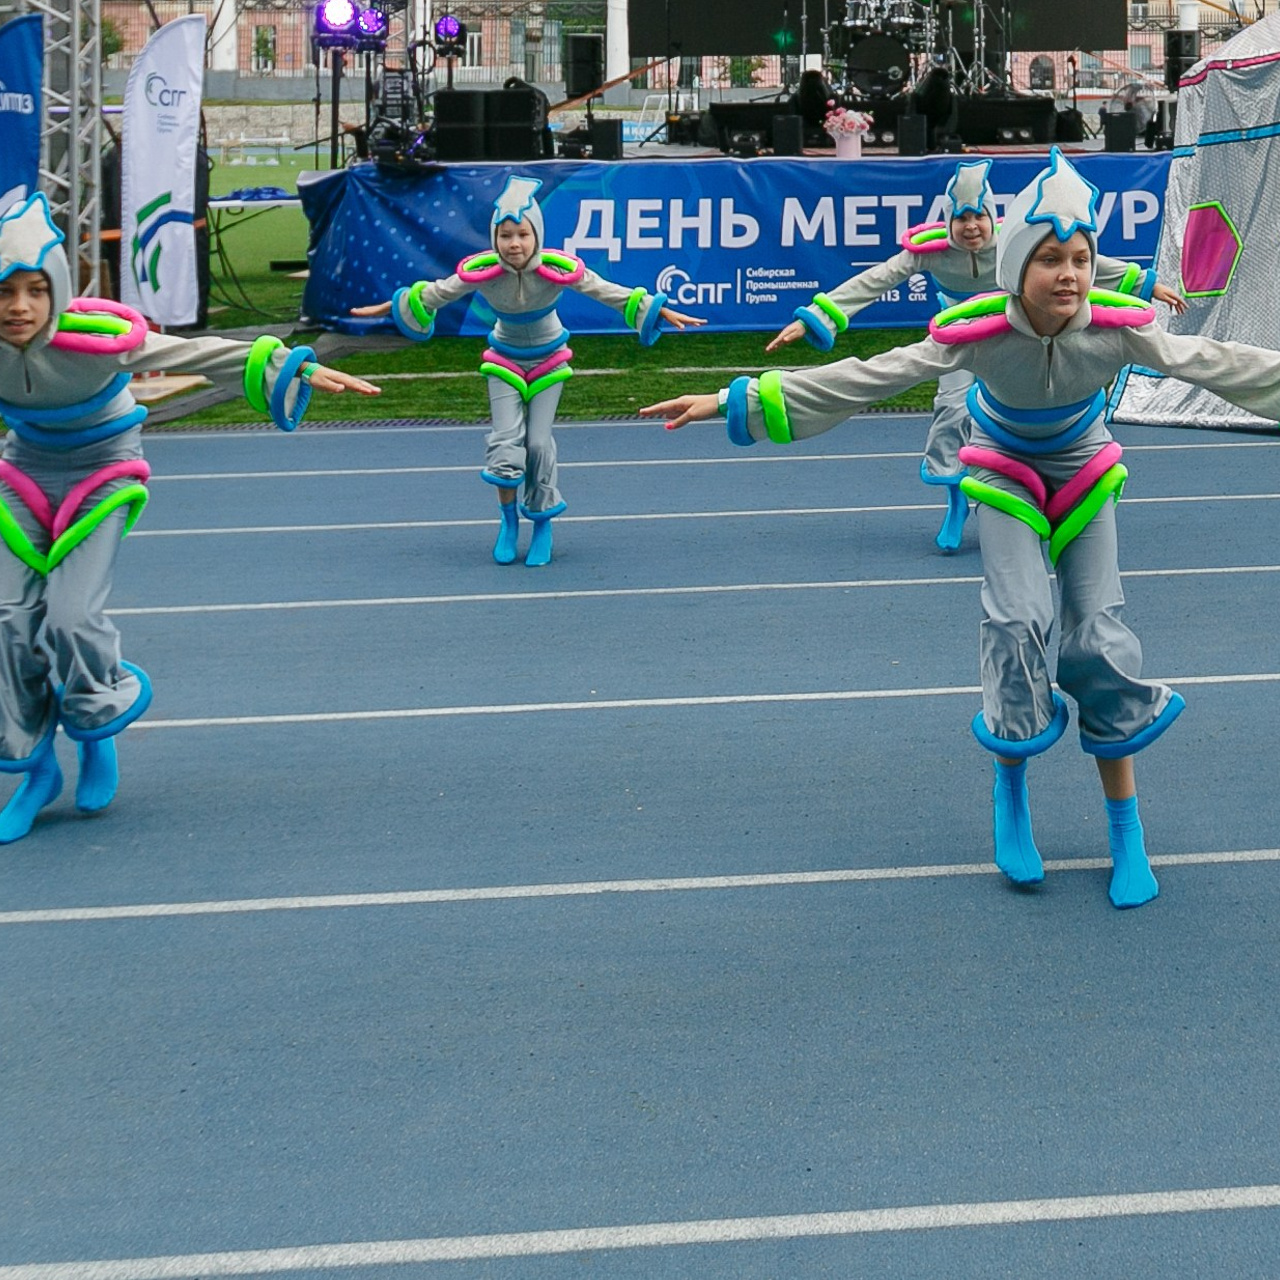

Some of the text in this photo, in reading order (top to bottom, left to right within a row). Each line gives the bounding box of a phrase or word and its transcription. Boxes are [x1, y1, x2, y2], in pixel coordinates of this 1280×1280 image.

[563, 197, 760, 262] ДЕНЬ
[745, 267, 796, 278] Сибирская
[745, 280, 820, 291] Промышленная
[677, 282, 732, 305] СПГ
[745, 293, 778, 304] Группа
[908, 293, 928, 302] СПХ
